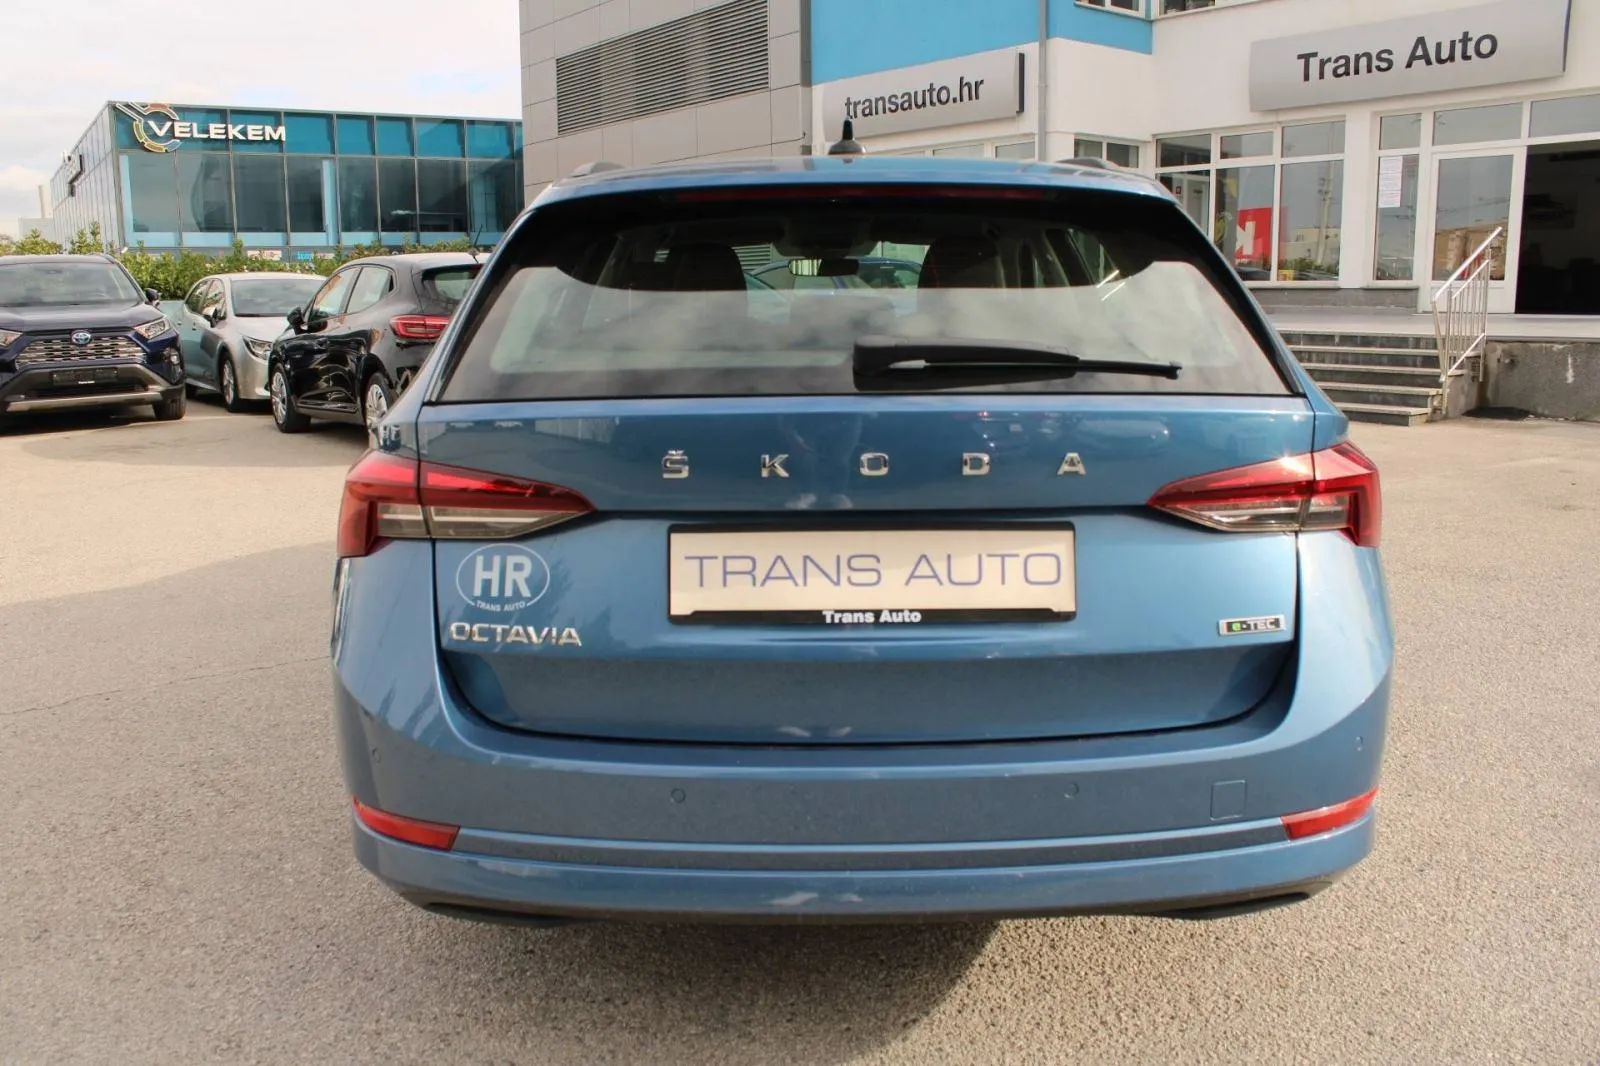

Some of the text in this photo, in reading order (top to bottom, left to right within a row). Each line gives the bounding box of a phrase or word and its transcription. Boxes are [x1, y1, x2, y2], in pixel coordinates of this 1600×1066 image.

[1297, 31, 1498, 82] Trans Auto
[845, 76, 985, 119] transauto.hr
[147, 120, 286, 142] VELEKEM
[473, 554, 532, 598] HR
[684, 553, 1062, 587] TRANS AUTO
[504, 601, 526, 612] AUTO
[822, 609, 922, 624] Trans Auto
[450, 621, 582, 647] OCTAVIA
